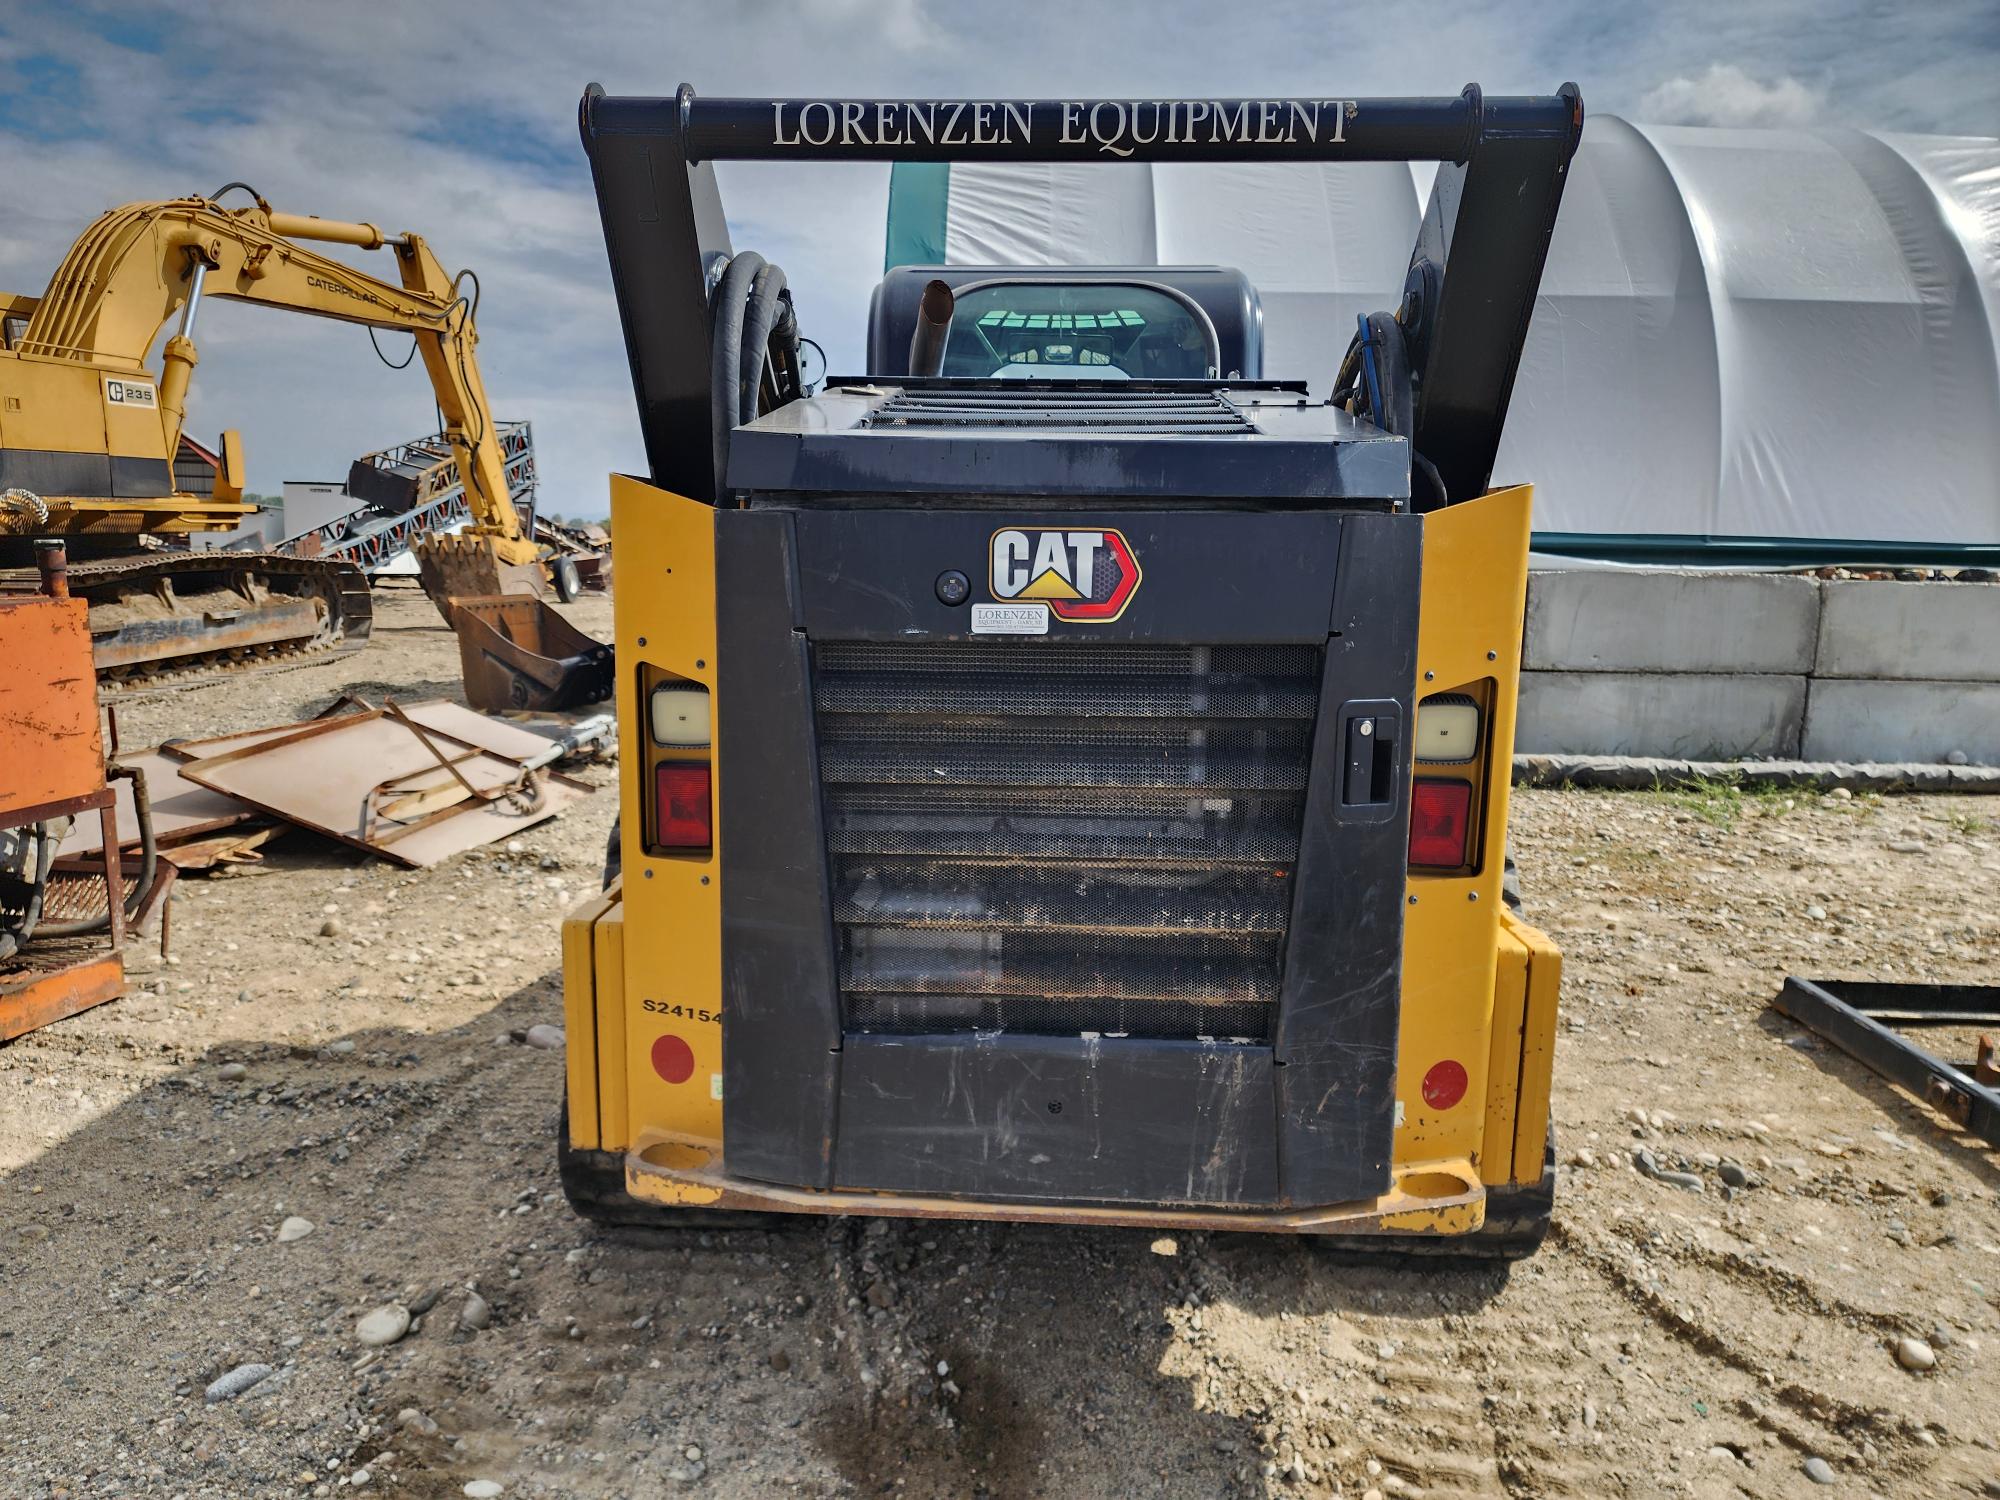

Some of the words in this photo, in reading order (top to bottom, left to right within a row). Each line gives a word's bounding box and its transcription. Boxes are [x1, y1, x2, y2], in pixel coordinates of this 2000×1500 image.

[771, 101, 1036, 146] LORENZEN
[1058, 100, 1357, 157] EQUIPMENT
[126, 389, 152, 401] 235
[993, 530, 1103, 599] CAT
[978, 610, 1043, 619] LORENZEN
[642, 999, 722, 1025] S24154
